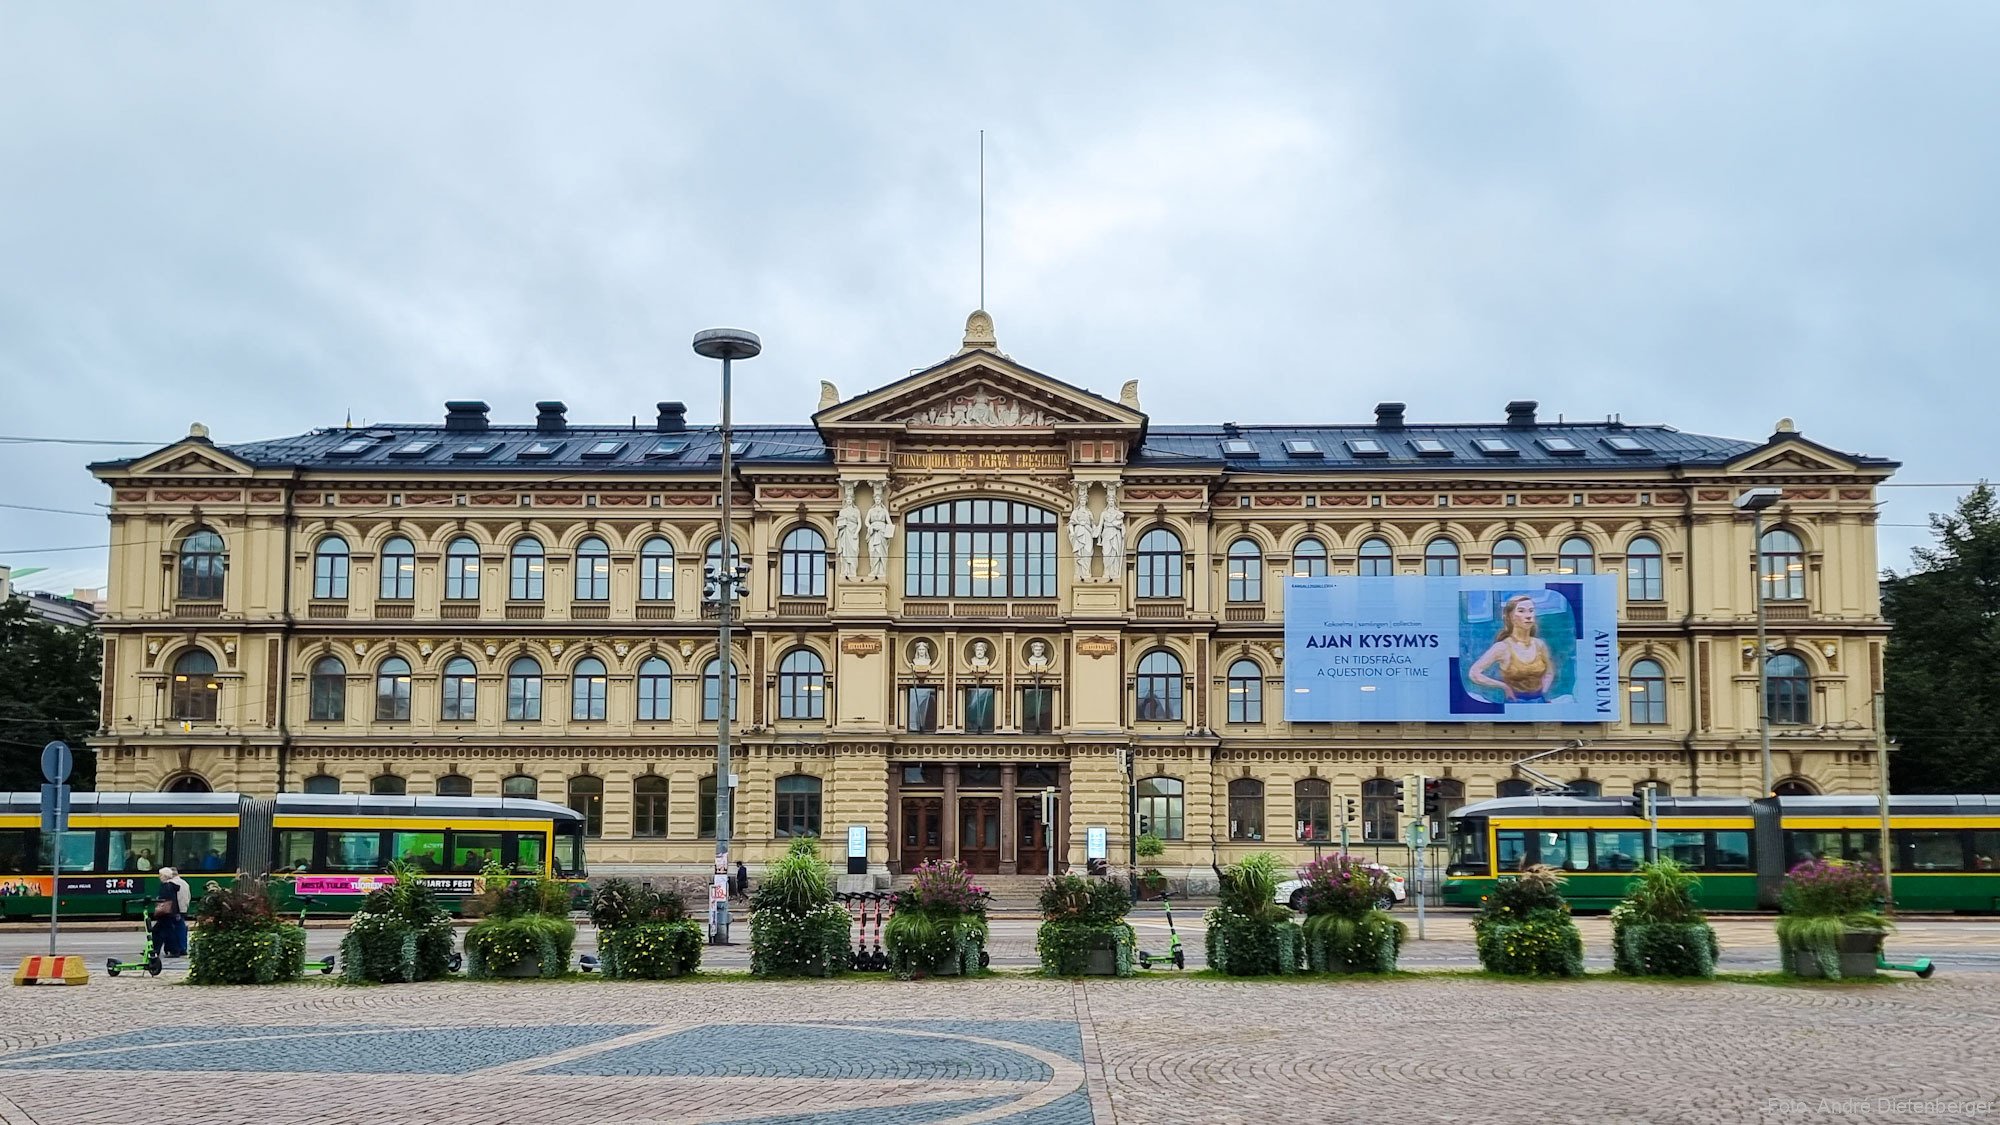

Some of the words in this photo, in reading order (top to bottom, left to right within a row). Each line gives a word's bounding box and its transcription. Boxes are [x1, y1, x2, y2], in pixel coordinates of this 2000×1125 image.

[955, 454, 974, 468] RES
[1016, 454, 1066, 468] CRESCUNT
[1306, 635, 1352, 648] AJAN
[1359, 634, 1439, 648] KYSYMYS
[1334, 655, 1349, 665] EN
[1353, 653, 1412, 665] TIDSFRÅGA
[1317, 667, 1325, 677] A
[1327, 667, 1383, 679] QUESTION
[1385, 667, 1402, 677] OF
[1405, 667, 1429, 677] TIME
[1594, 629, 1612, 713] ATENEUM
[1547, 832, 1558, 846] 7
[452, 880, 472, 888] FEST
